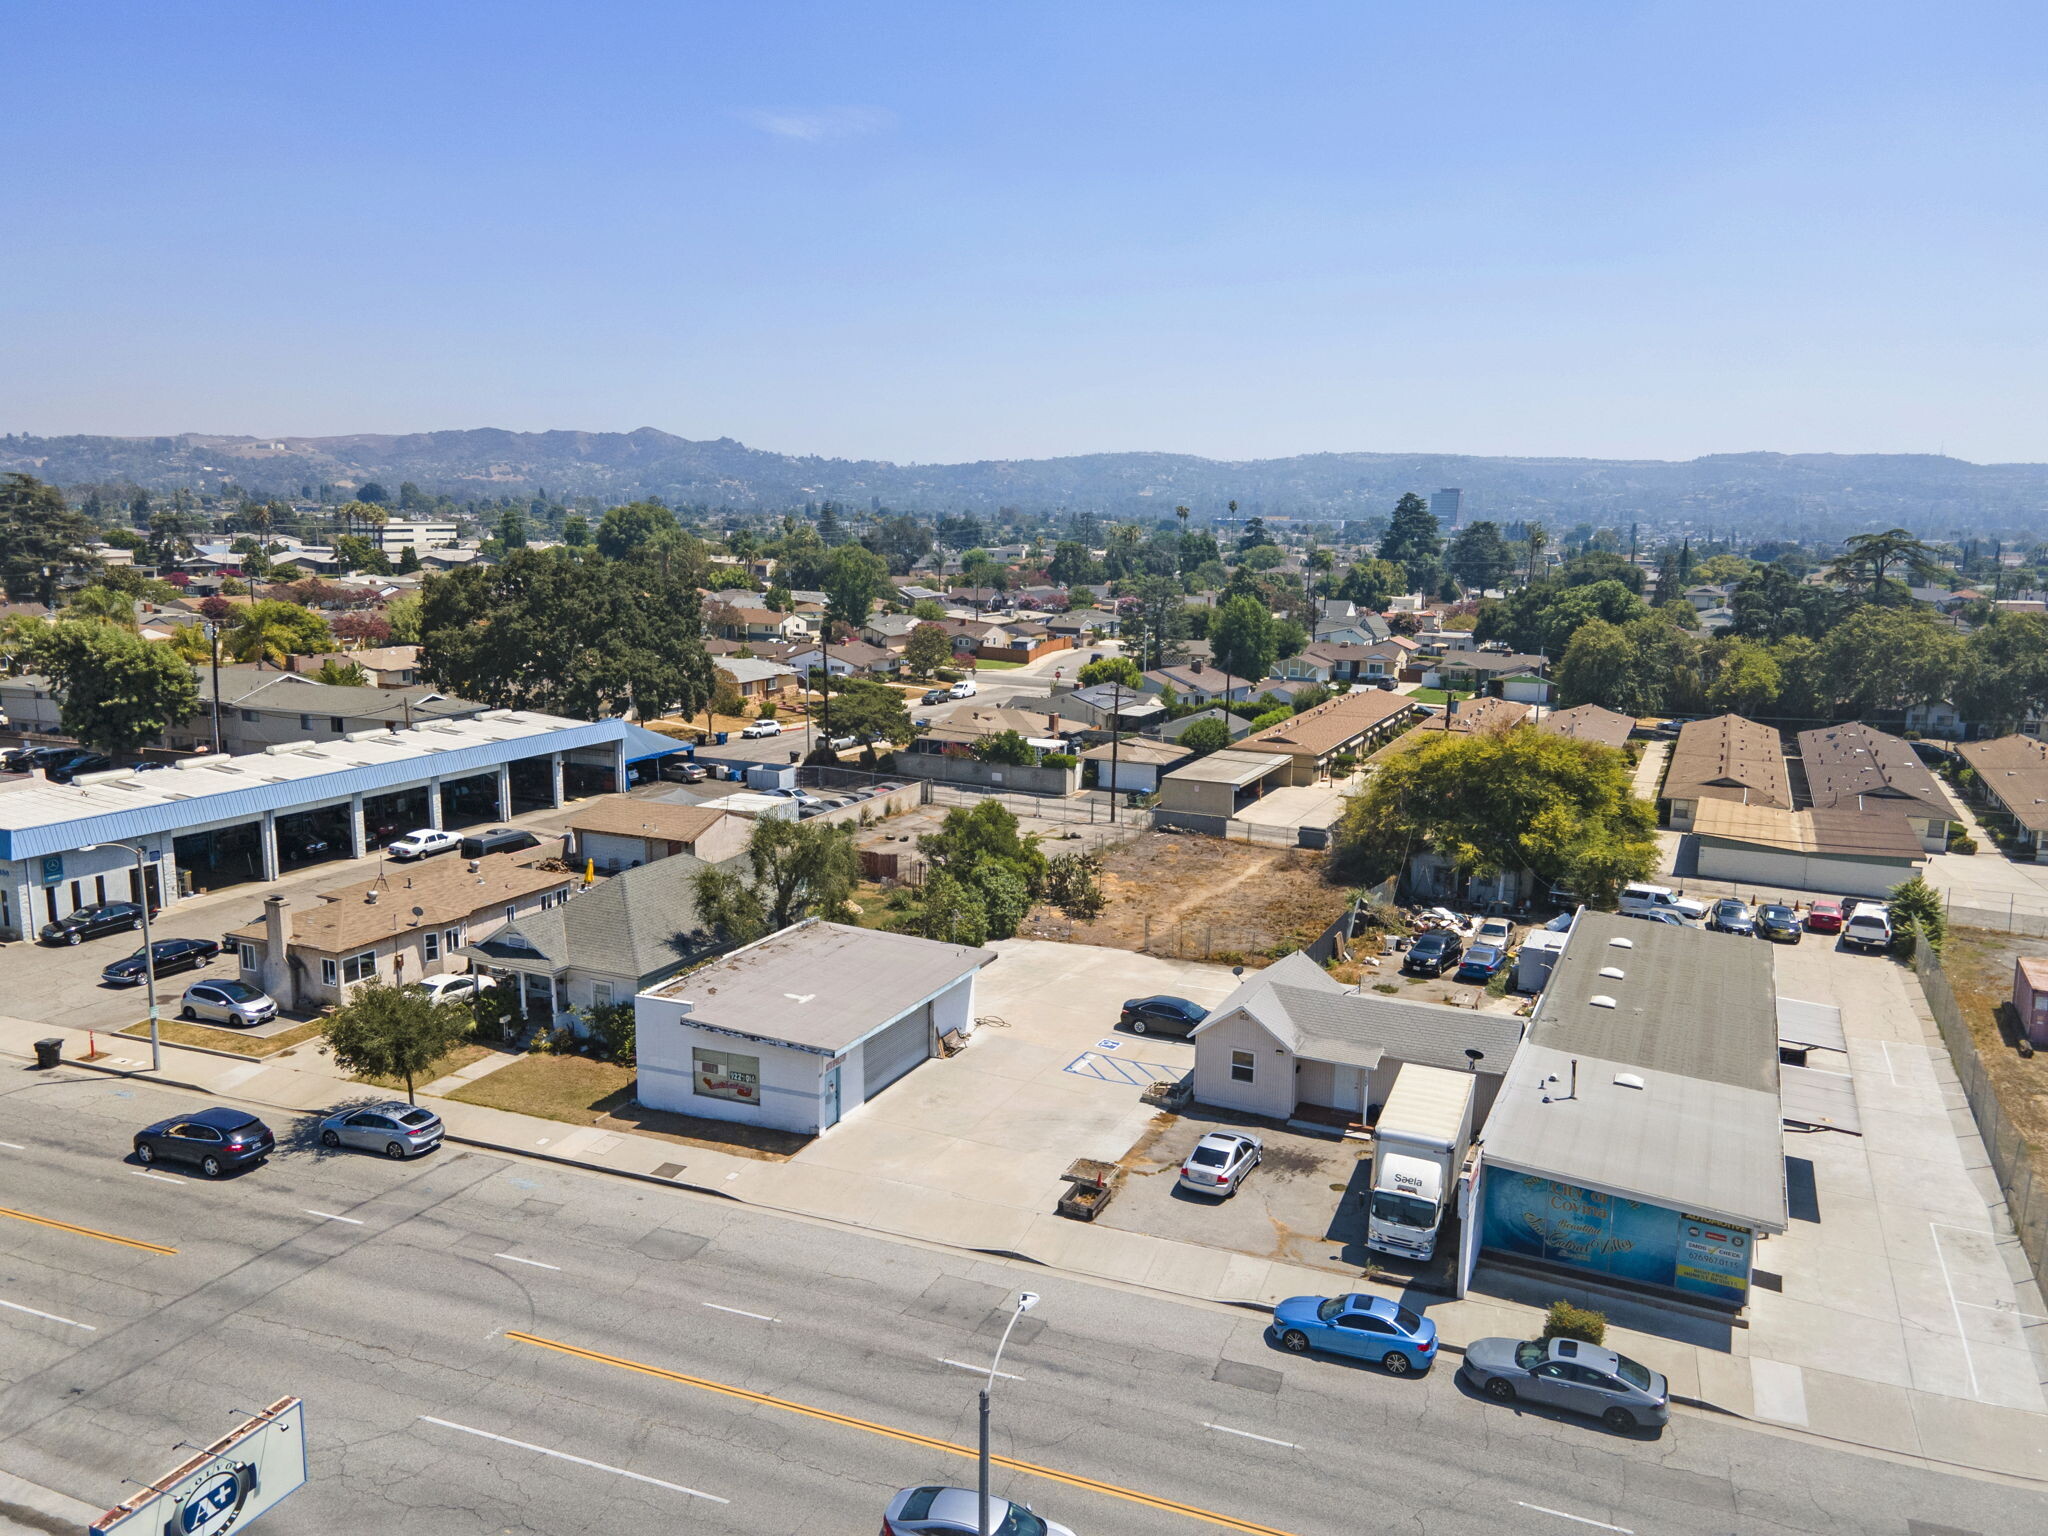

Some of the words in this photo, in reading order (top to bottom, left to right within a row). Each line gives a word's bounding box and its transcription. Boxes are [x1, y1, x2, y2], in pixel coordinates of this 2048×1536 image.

[1394, 1173, 1423, 1187] Saela
[1551, 1195, 1608, 1219] Covina
[190, 1485, 232, 1530] A+
